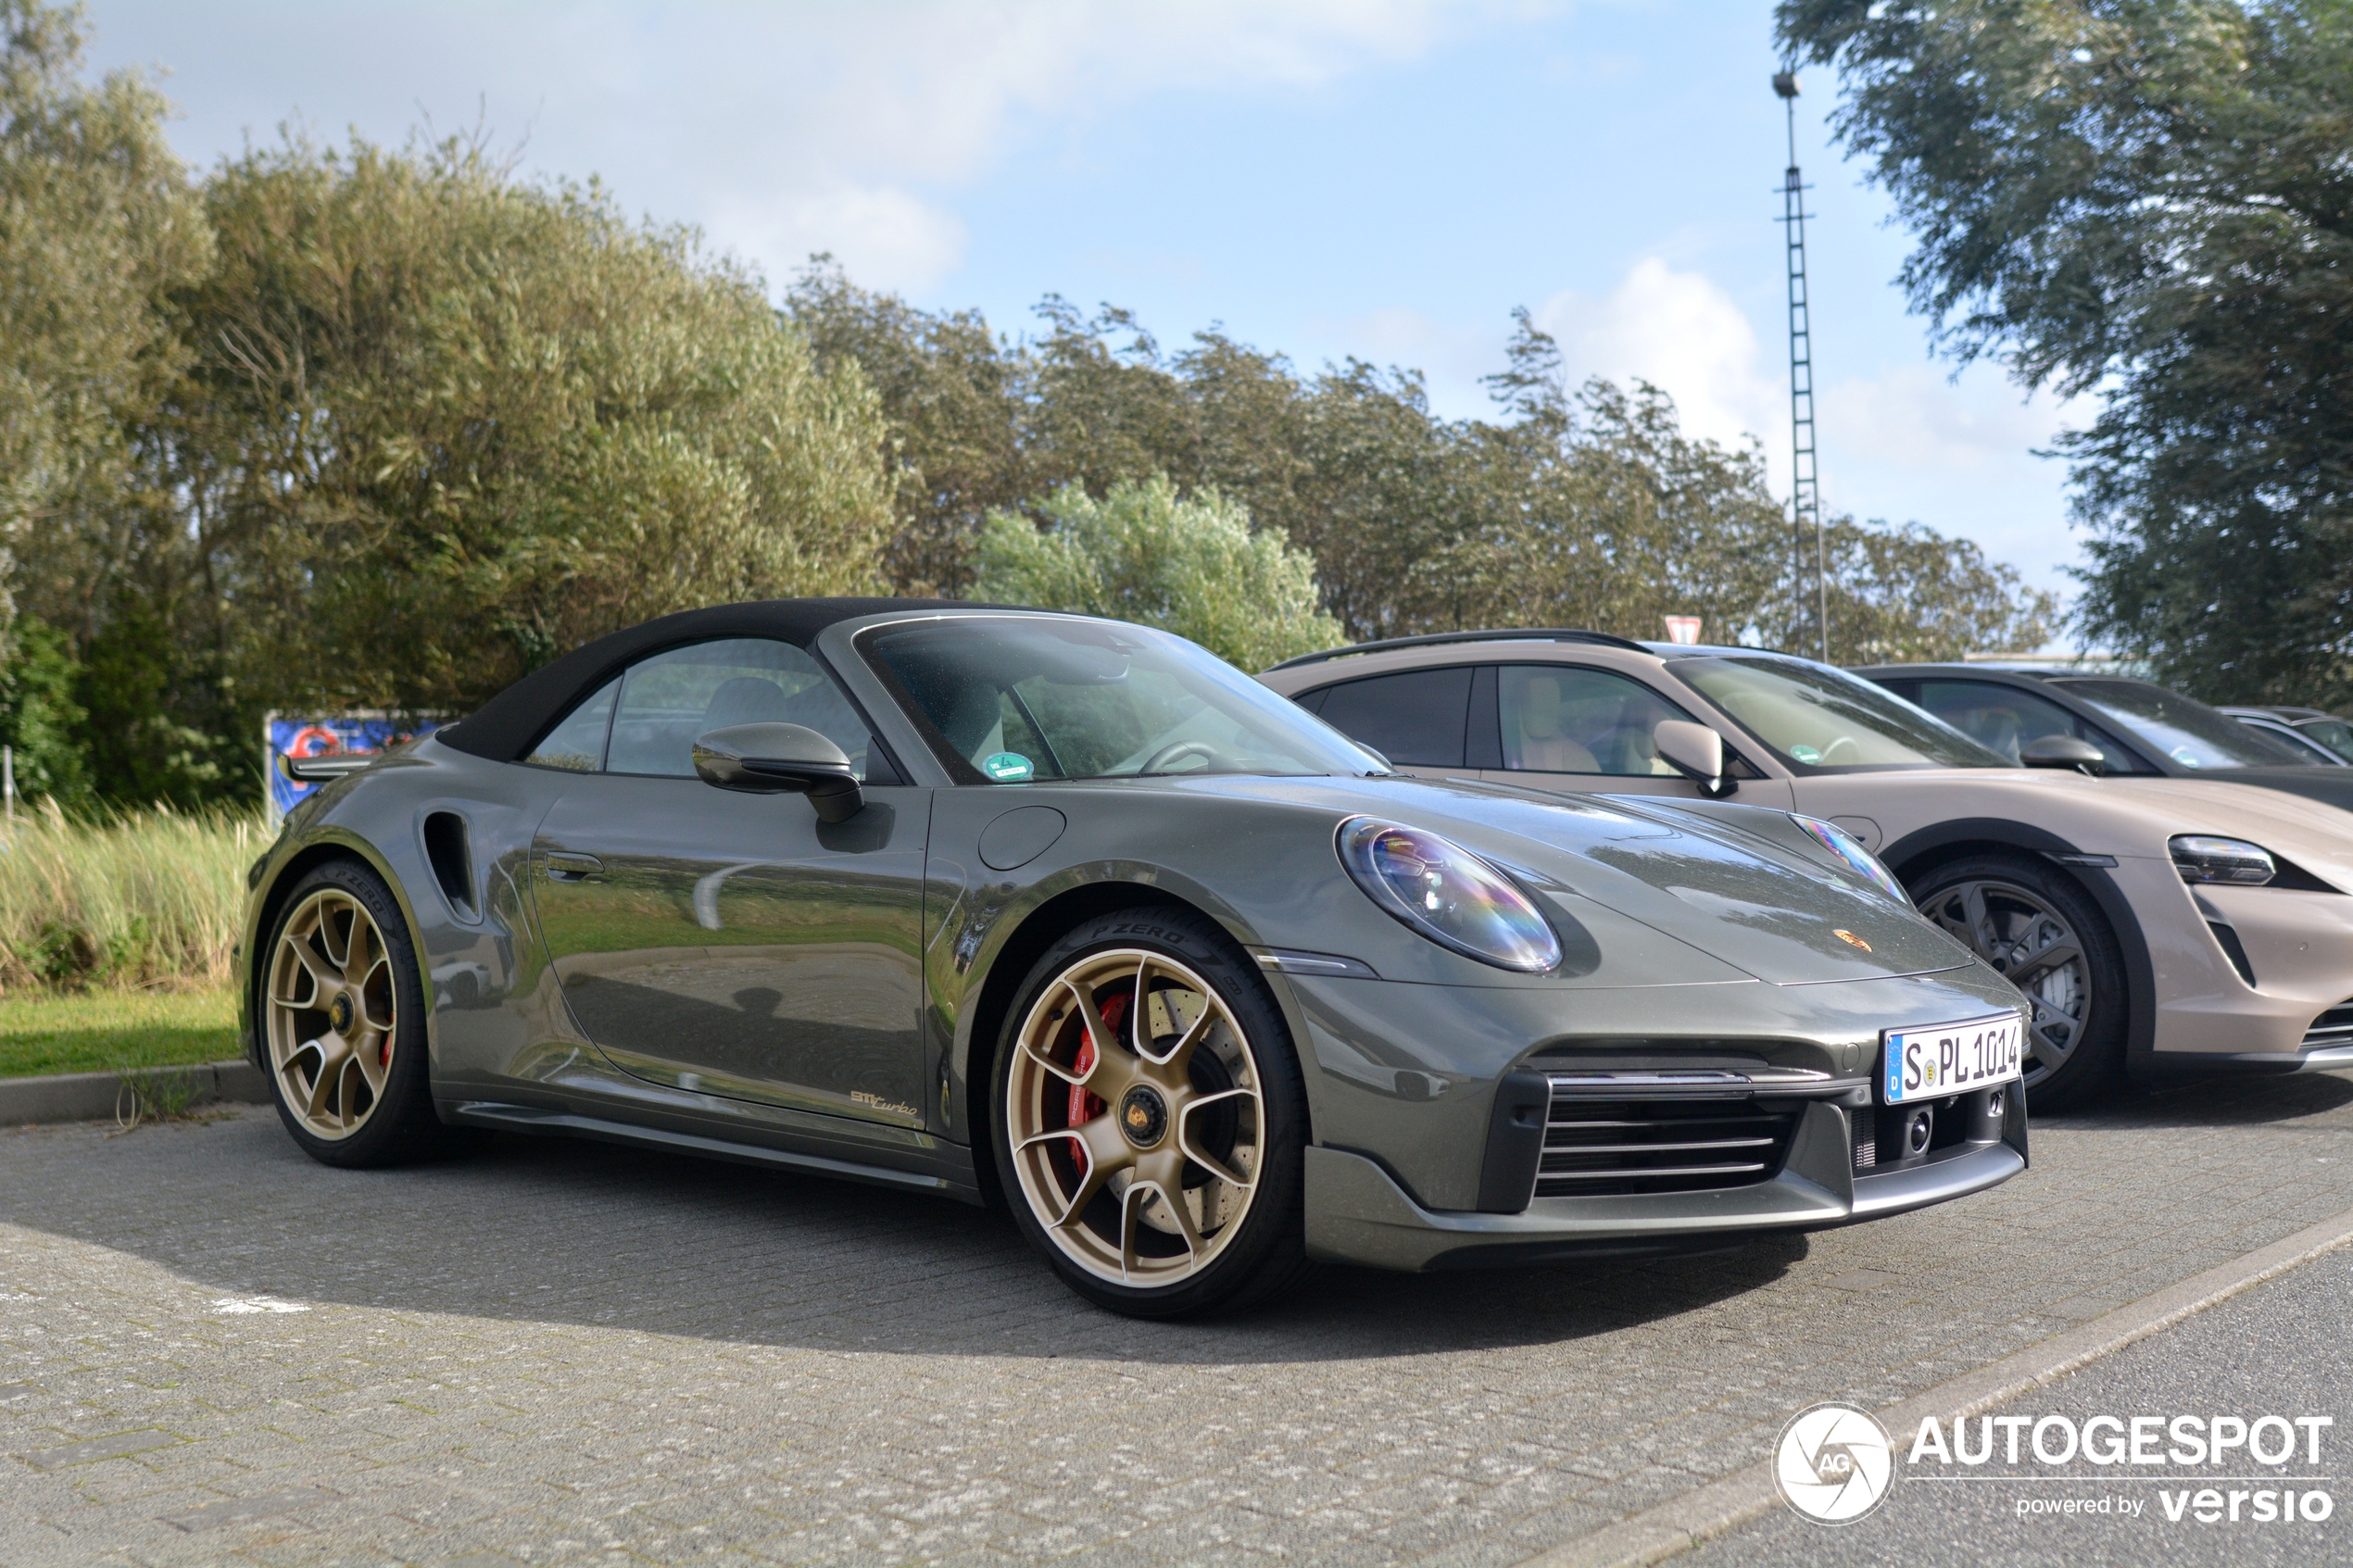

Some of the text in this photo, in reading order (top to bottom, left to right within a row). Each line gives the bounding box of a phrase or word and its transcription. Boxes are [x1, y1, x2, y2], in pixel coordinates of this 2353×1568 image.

[1000, 757, 1013, 768] 4
[347, 874, 384, 912] ZERO
[1091, 923, 1185, 944] P ZERO
[1906, 1026, 2017, 1090] S PL 1014
[1072, 1056, 1086, 1120] PORSHE
[1892, 1076, 1898, 1090] D
